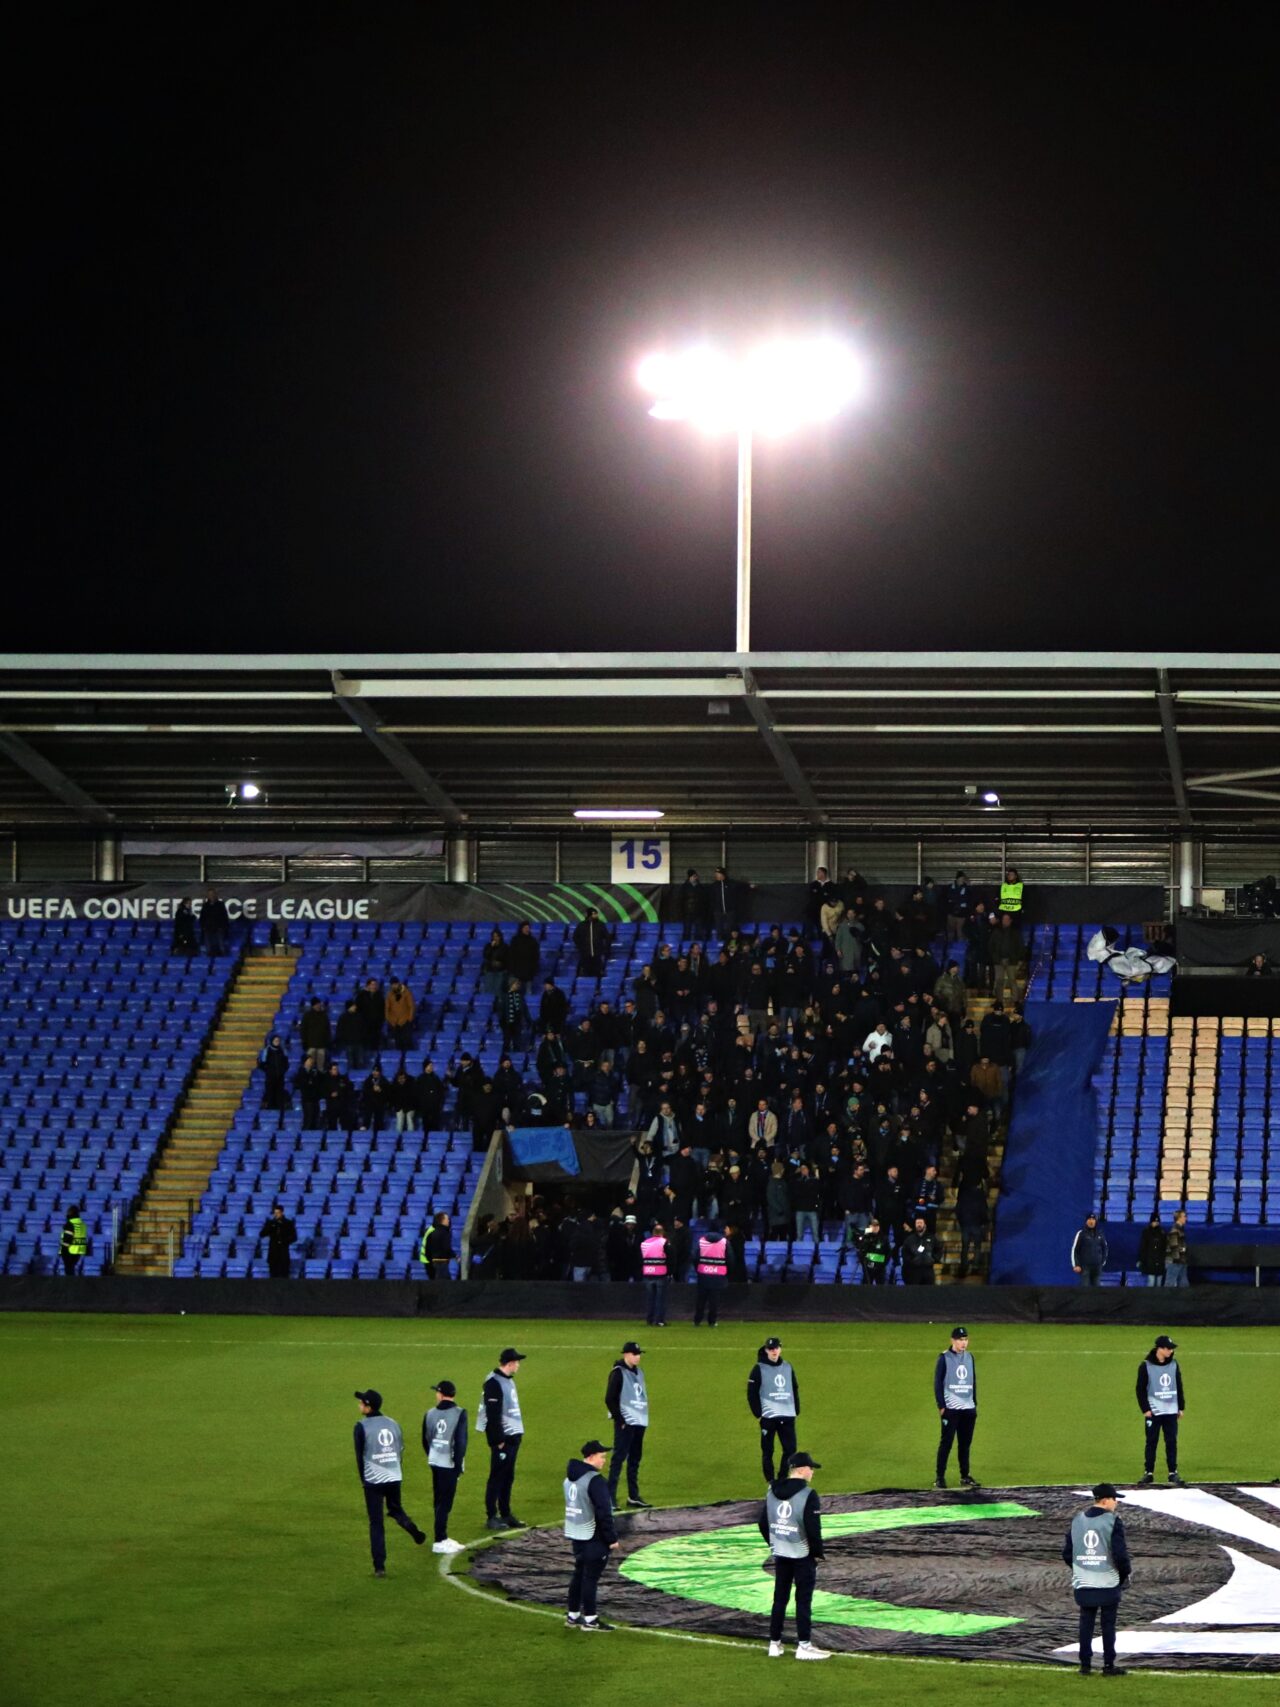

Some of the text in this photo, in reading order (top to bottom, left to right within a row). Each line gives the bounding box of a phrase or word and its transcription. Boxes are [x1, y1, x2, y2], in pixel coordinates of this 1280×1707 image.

[619, 838, 662, 869] 15
[8, 898, 77, 919] UEFA
[267, 898, 369, 919] LEAGUE
